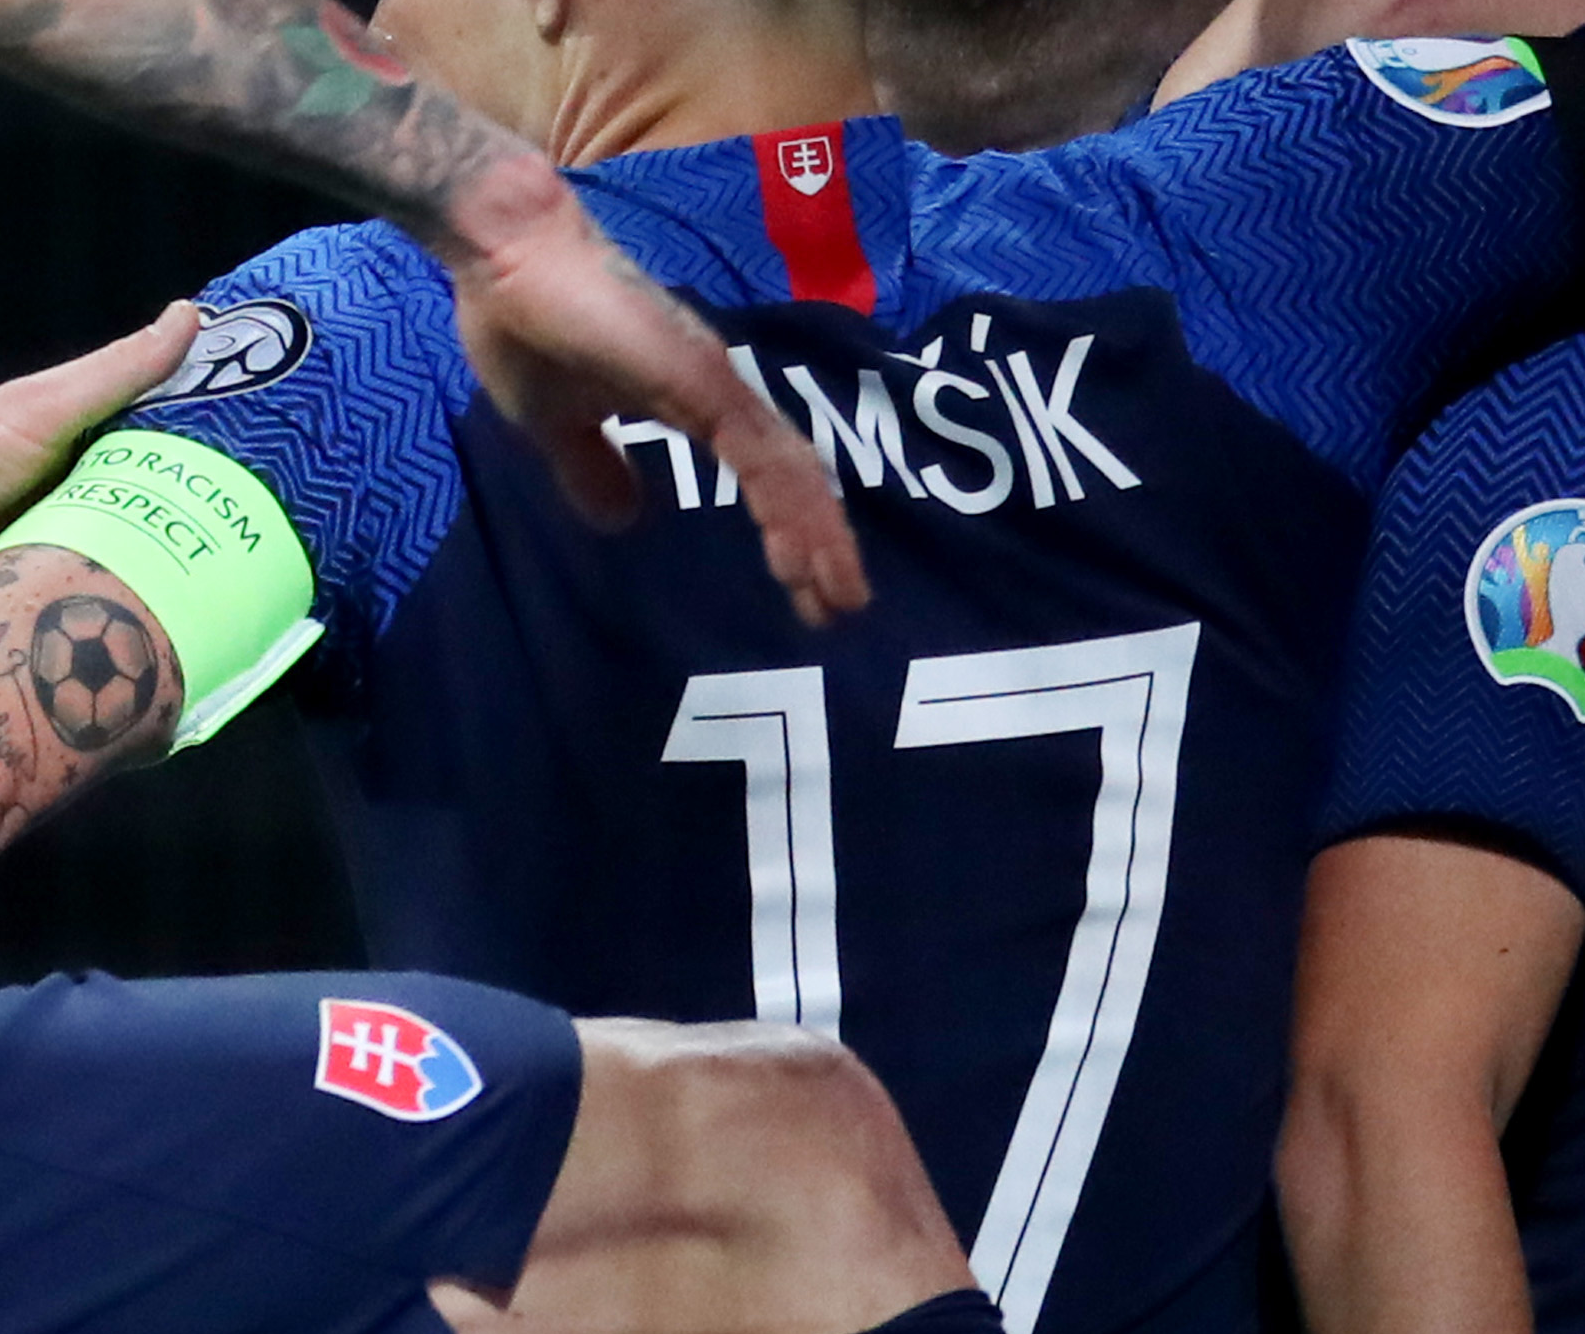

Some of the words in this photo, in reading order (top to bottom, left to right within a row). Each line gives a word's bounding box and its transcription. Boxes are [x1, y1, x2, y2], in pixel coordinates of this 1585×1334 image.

[56, 484, 214, 560] RESPECT
[89, 448, 133, 467] TO
[136, 452, 261, 553] RACISM
